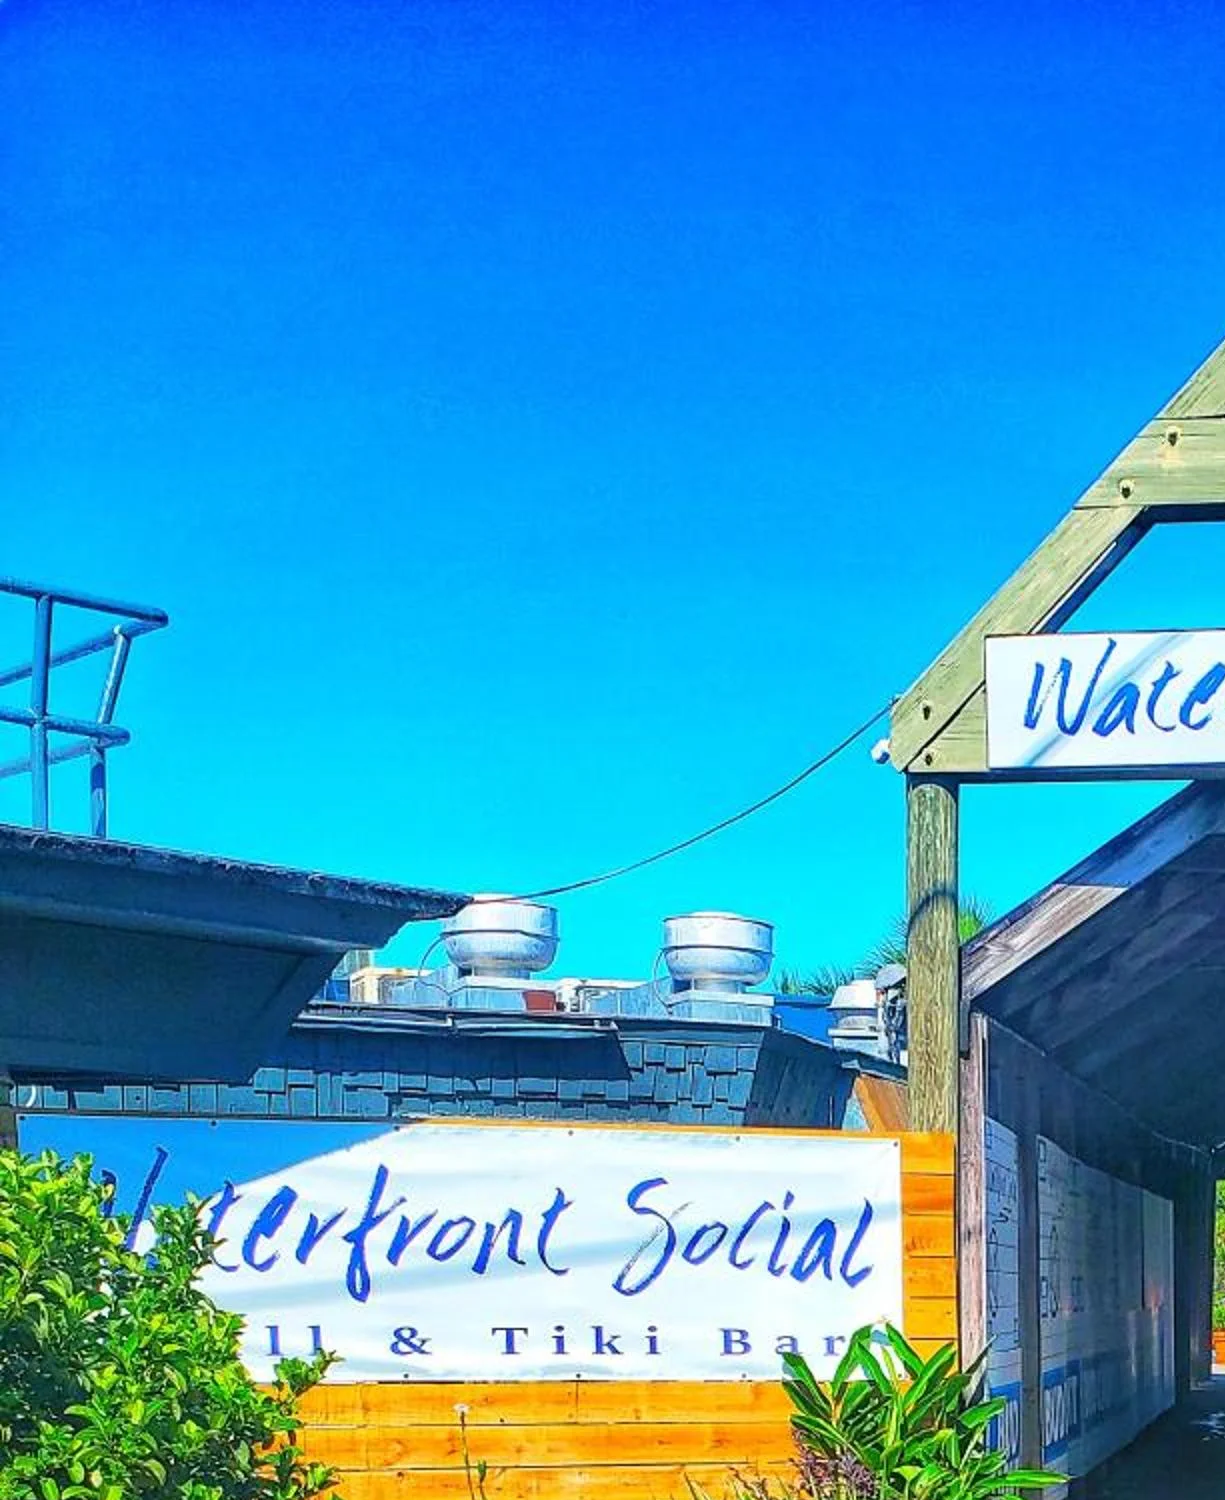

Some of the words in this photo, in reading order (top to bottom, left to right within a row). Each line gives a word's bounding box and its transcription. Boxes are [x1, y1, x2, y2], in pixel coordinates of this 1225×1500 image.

[101, 1146, 571, 1303] terfront
[611, 1177, 875, 1297] Social
[389, 1325, 432, 1356] &
[491, 1325, 661, 1356] Tiki
[718, 1327, 846, 1356] Bar
